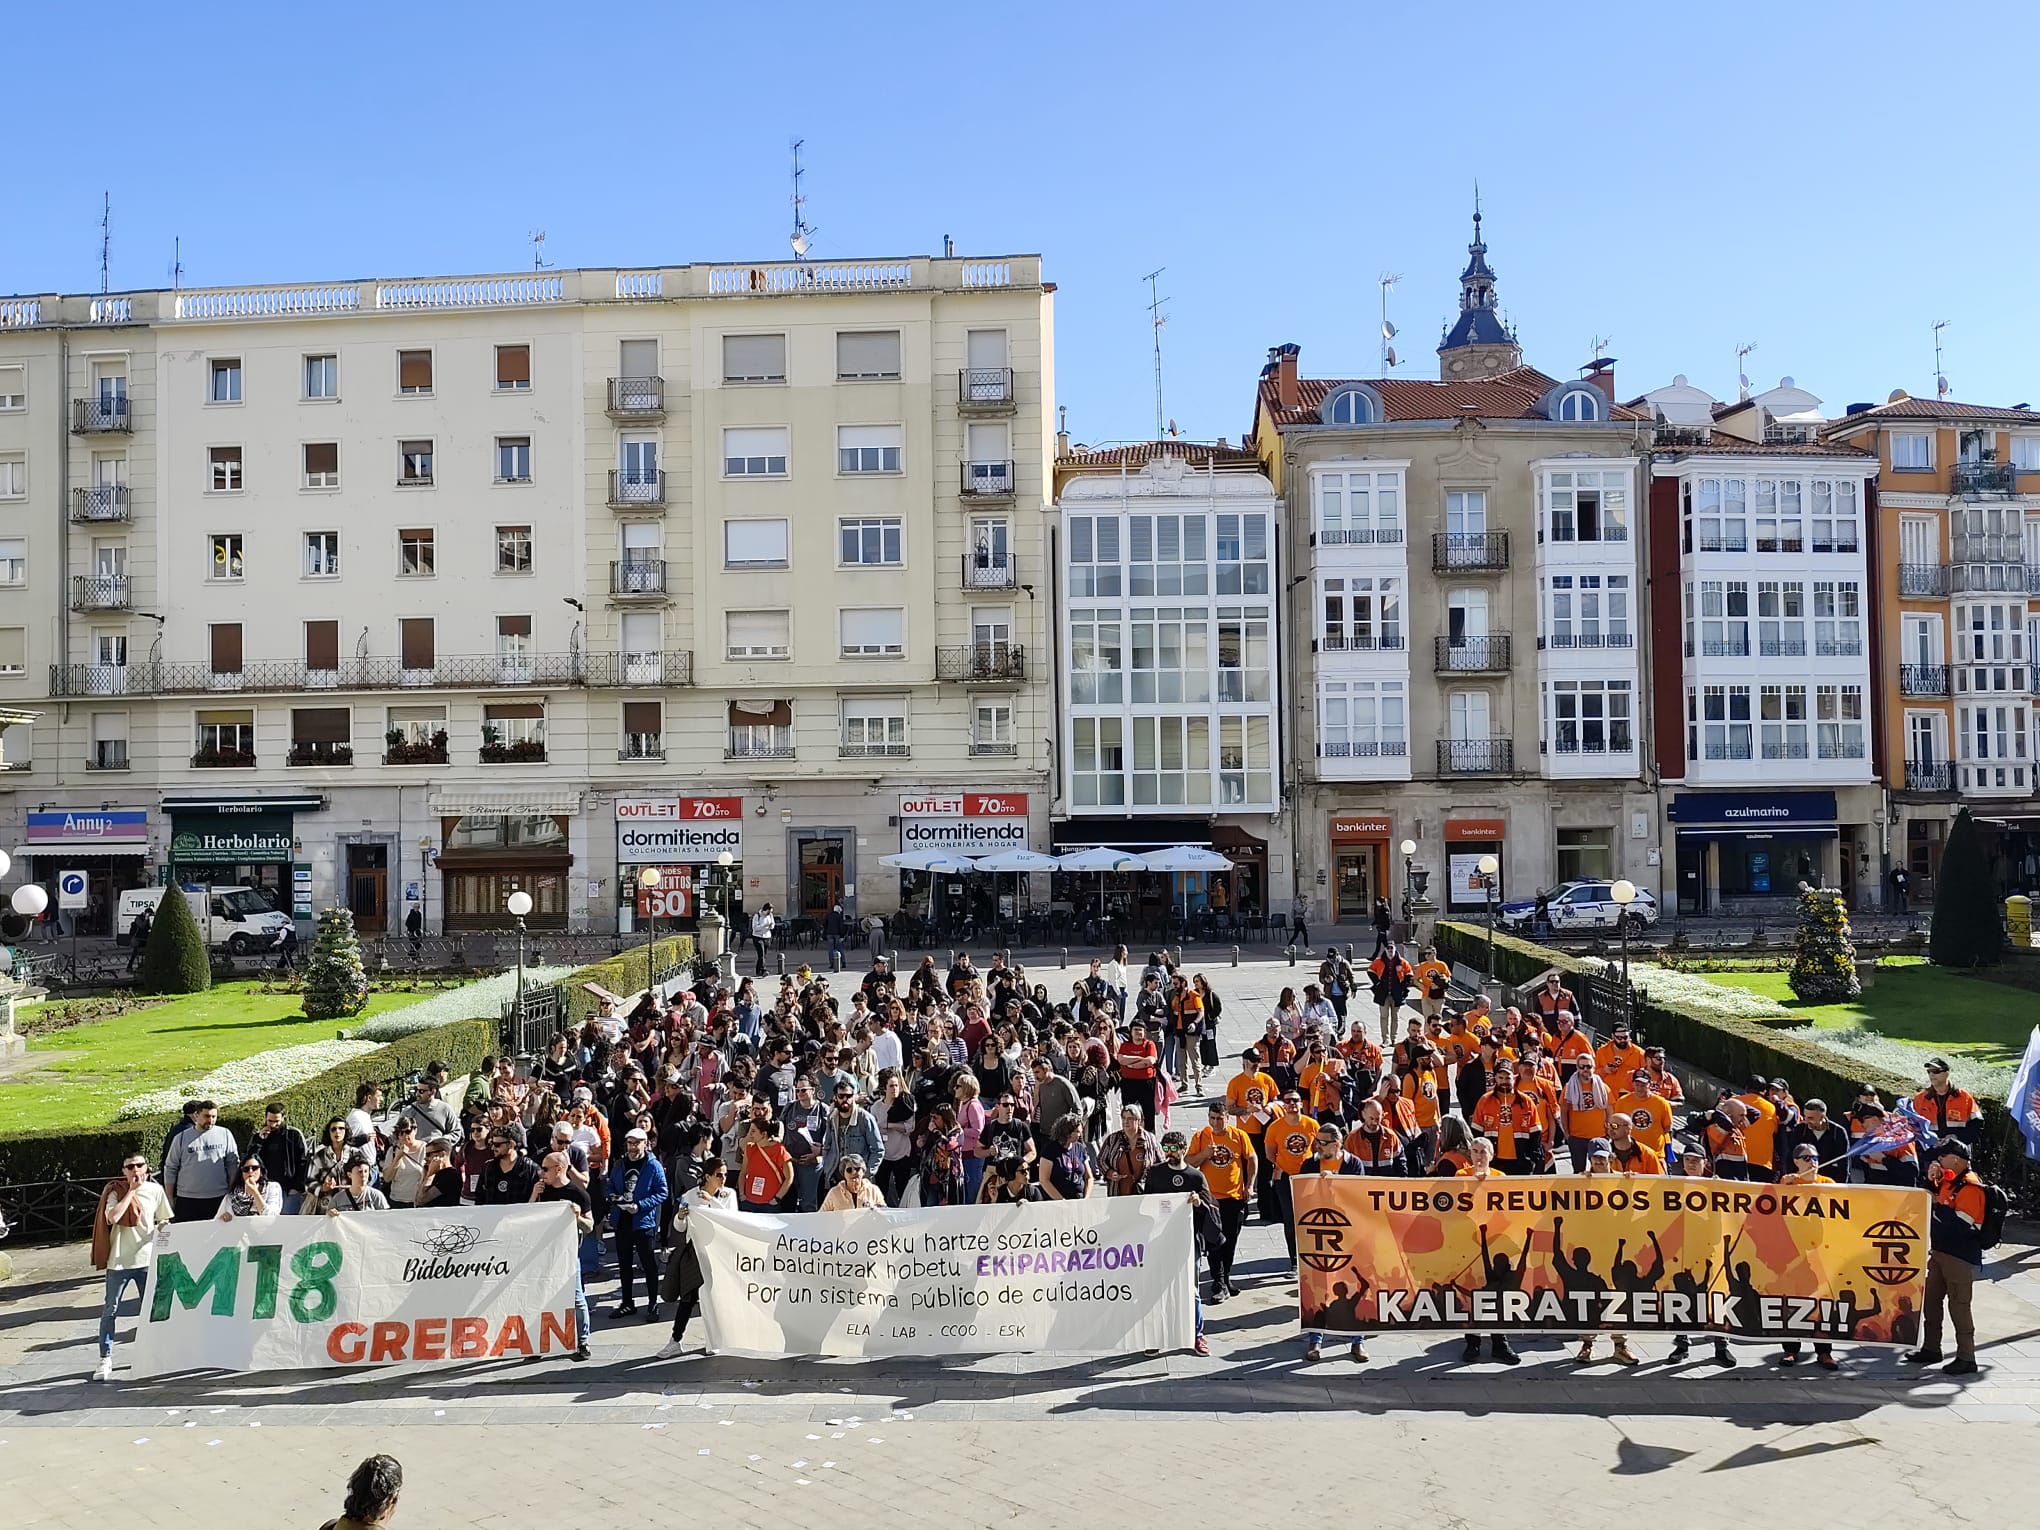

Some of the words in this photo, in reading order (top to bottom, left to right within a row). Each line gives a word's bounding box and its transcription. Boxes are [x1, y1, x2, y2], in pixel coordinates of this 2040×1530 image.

[218, 804, 262, 812] Herbolario
[618, 804, 676, 816] OUTLET
[693, 800, 715, 816] 70
[903, 800, 961, 812] OUTLET
[978, 798, 1000, 813] 70
[1725, 805, 1790, 816] azulmarino
[63, 812, 103, 835] Anny
[106, 819, 112, 830] 2
[906, 822, 1024, 840] dormitienda
[203, 833, 290, 848] Herbolario
[622, 828, 739, 845] dormitienda
[1368, 1190, 1474, 1212] TUBOS
[1486, 1190, 1650, 1212] REUNIDOS
[1663, 1190, 1850, 1219] BORROKAN
[776, 1234, 859, 1255] Arabako
[867, 1234, 914, 1256] esku
[925, 1233, 989, 1252] hartze
[997, 1225, 1098, 1250] sozialeko
[1306, 1228, 1343, 1251] TR
[773, 1255, 877, 1279] baldintzak
[887, 1257, 960, 1280] hobetu
[976, 1243, 1144, 1276] EKIPARAZIOA!
[1872, 1242, 1910, 1264] TR
[402, 1256, 510, 1282] Bideberria
[150, 1242, 343, 1323] M18
[747, 1283, 782, 1304] Por
[789, 1286, 812, 1303] un
[820, 1286, 898, 1308] sistema
[912, 1284, 989, 1310] público
[998, 1285, 1023, 1304] de
[1033, 1279, 1132, 1302] cuidados
[1378, 1290, 1743, 1327] KALERATZERIK
[1760, 1296, 1850, 1332] EZ!!
[326, 1308, 576, 1363] GREBAN
[847, 1324, 870, 1336] ELA
[892, 1326, 916, 1338] LAB
[941, 1324, 977, 1337] CCOO
[999, 1325, 1026, 1337] ESK
